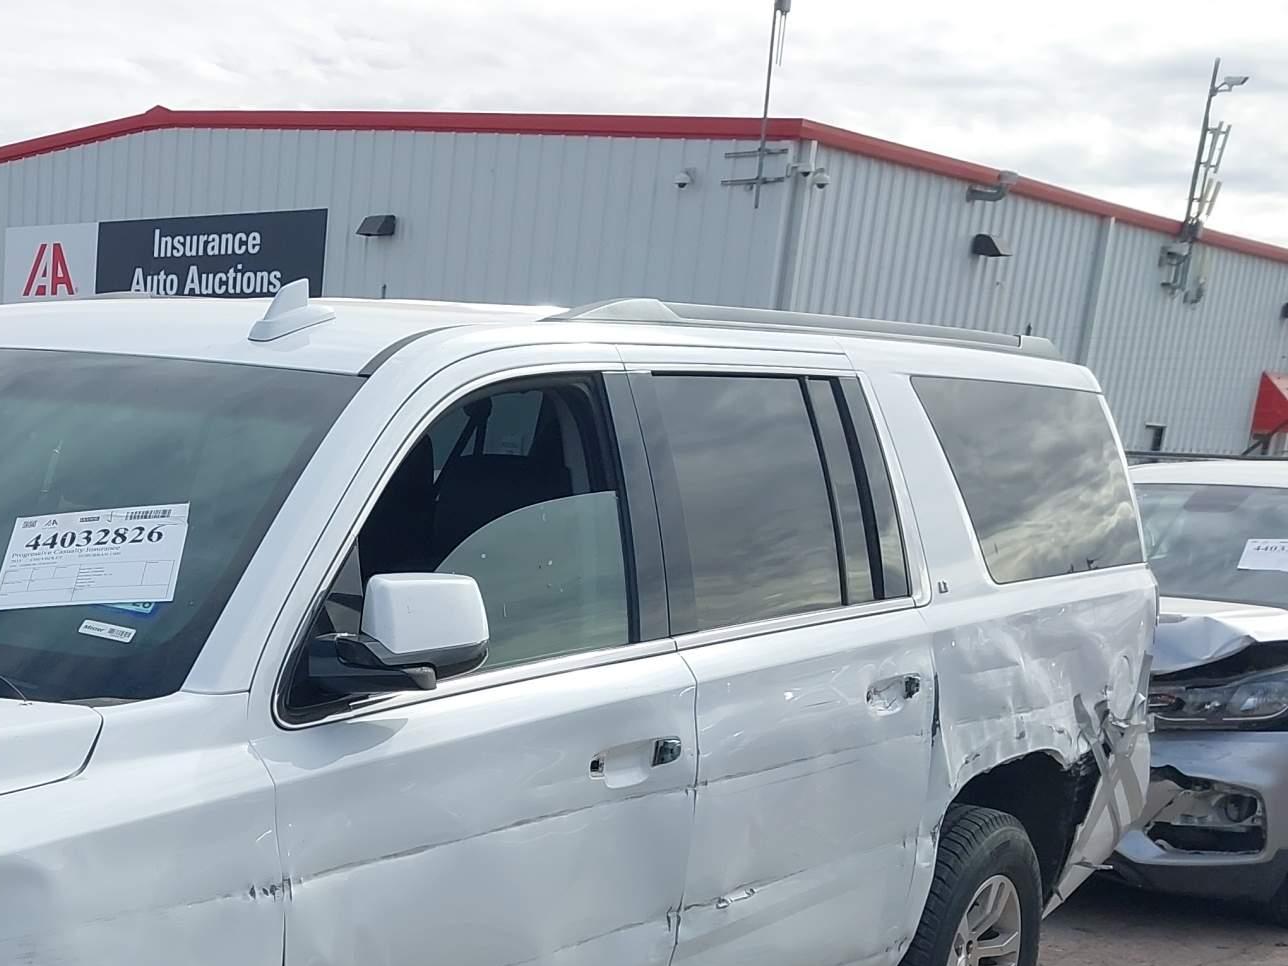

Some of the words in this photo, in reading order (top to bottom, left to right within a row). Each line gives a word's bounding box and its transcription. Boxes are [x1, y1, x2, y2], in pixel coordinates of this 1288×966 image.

[153, 228, 261, 258] Insurance
[131, 267, 179, 295] Auto
[184, 264, 282, 295] Auctions
[25, 525, 165, 551] 44032826
